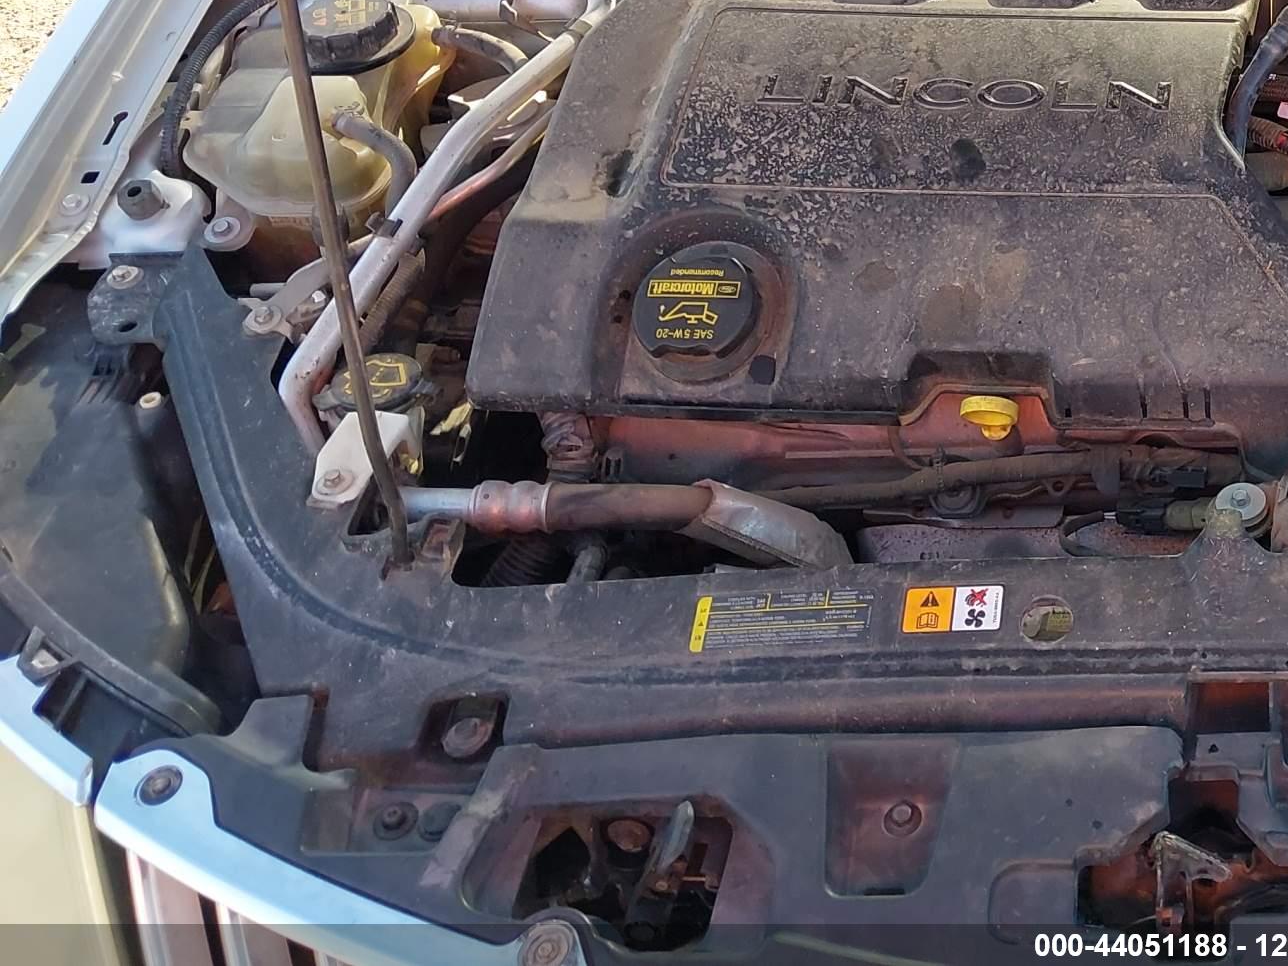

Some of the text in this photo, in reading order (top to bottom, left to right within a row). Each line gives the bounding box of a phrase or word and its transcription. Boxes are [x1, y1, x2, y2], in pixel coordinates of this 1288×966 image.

[756, 74, 1173, 111] LINCOLN
[670, 268, 724, 276] Recommended
[652, 282, 715, 295] Motorcraft
[693, 329, 714, 339] SAE
